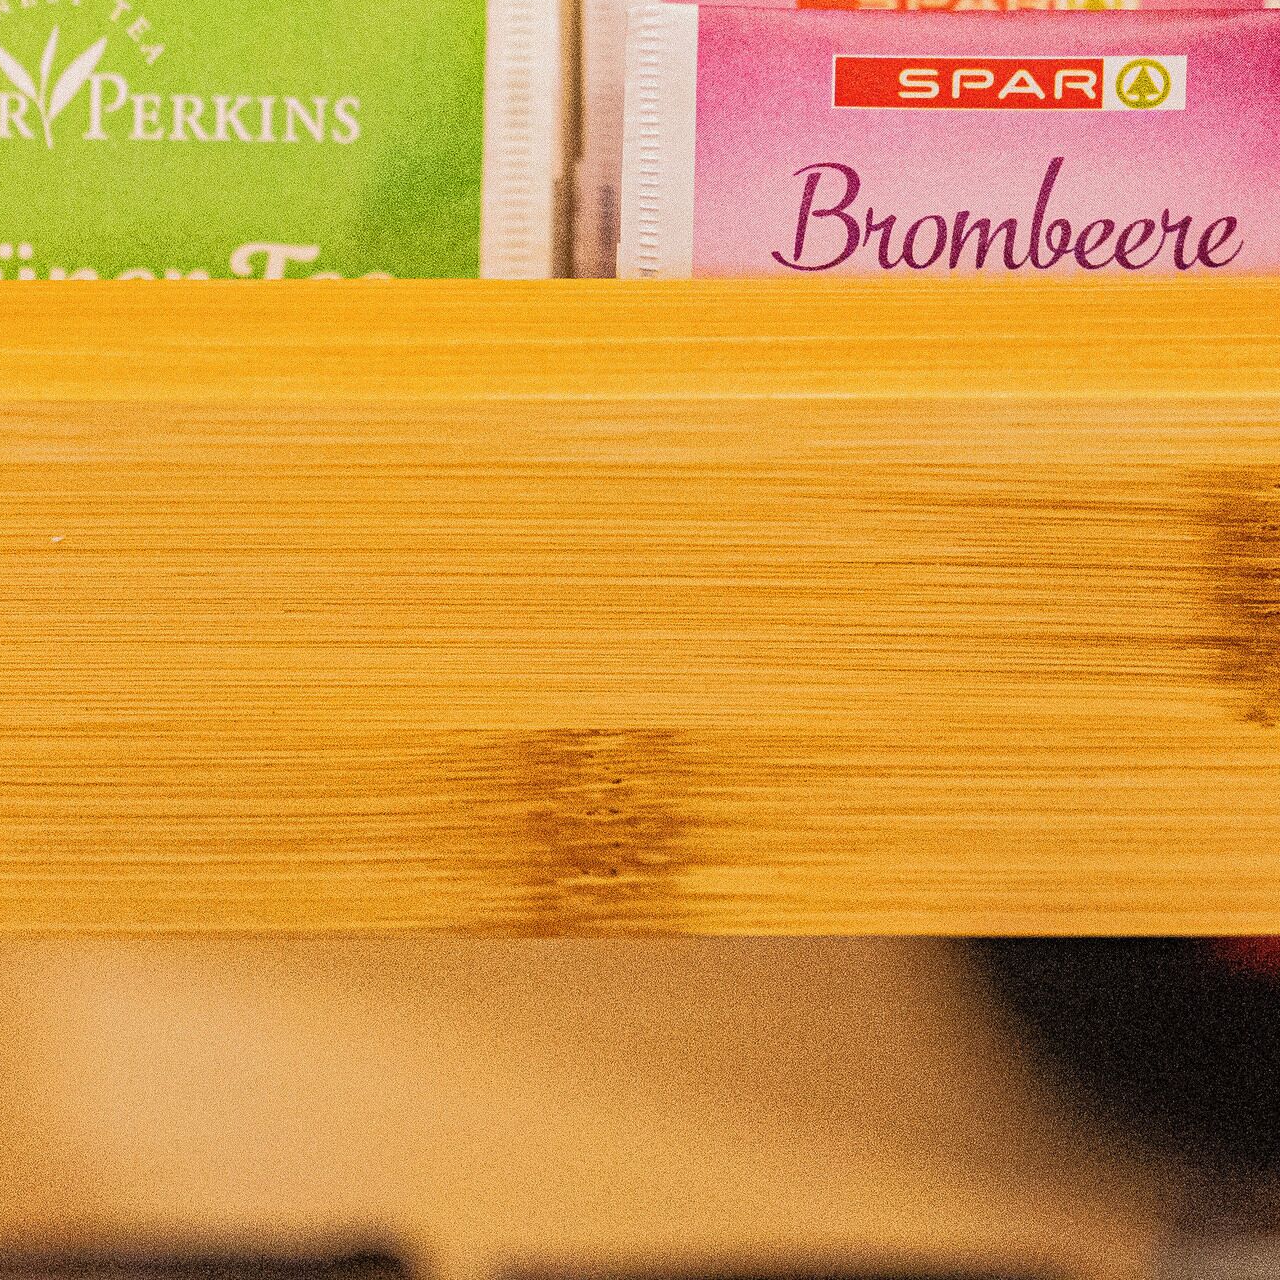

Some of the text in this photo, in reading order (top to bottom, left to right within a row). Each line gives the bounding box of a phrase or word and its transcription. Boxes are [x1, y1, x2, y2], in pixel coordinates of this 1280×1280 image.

[83, 71, 361, 144] PERKINS
[898, 68, 1097, 99] SPAR
[771, 156, 1244, 271] Brombeere
